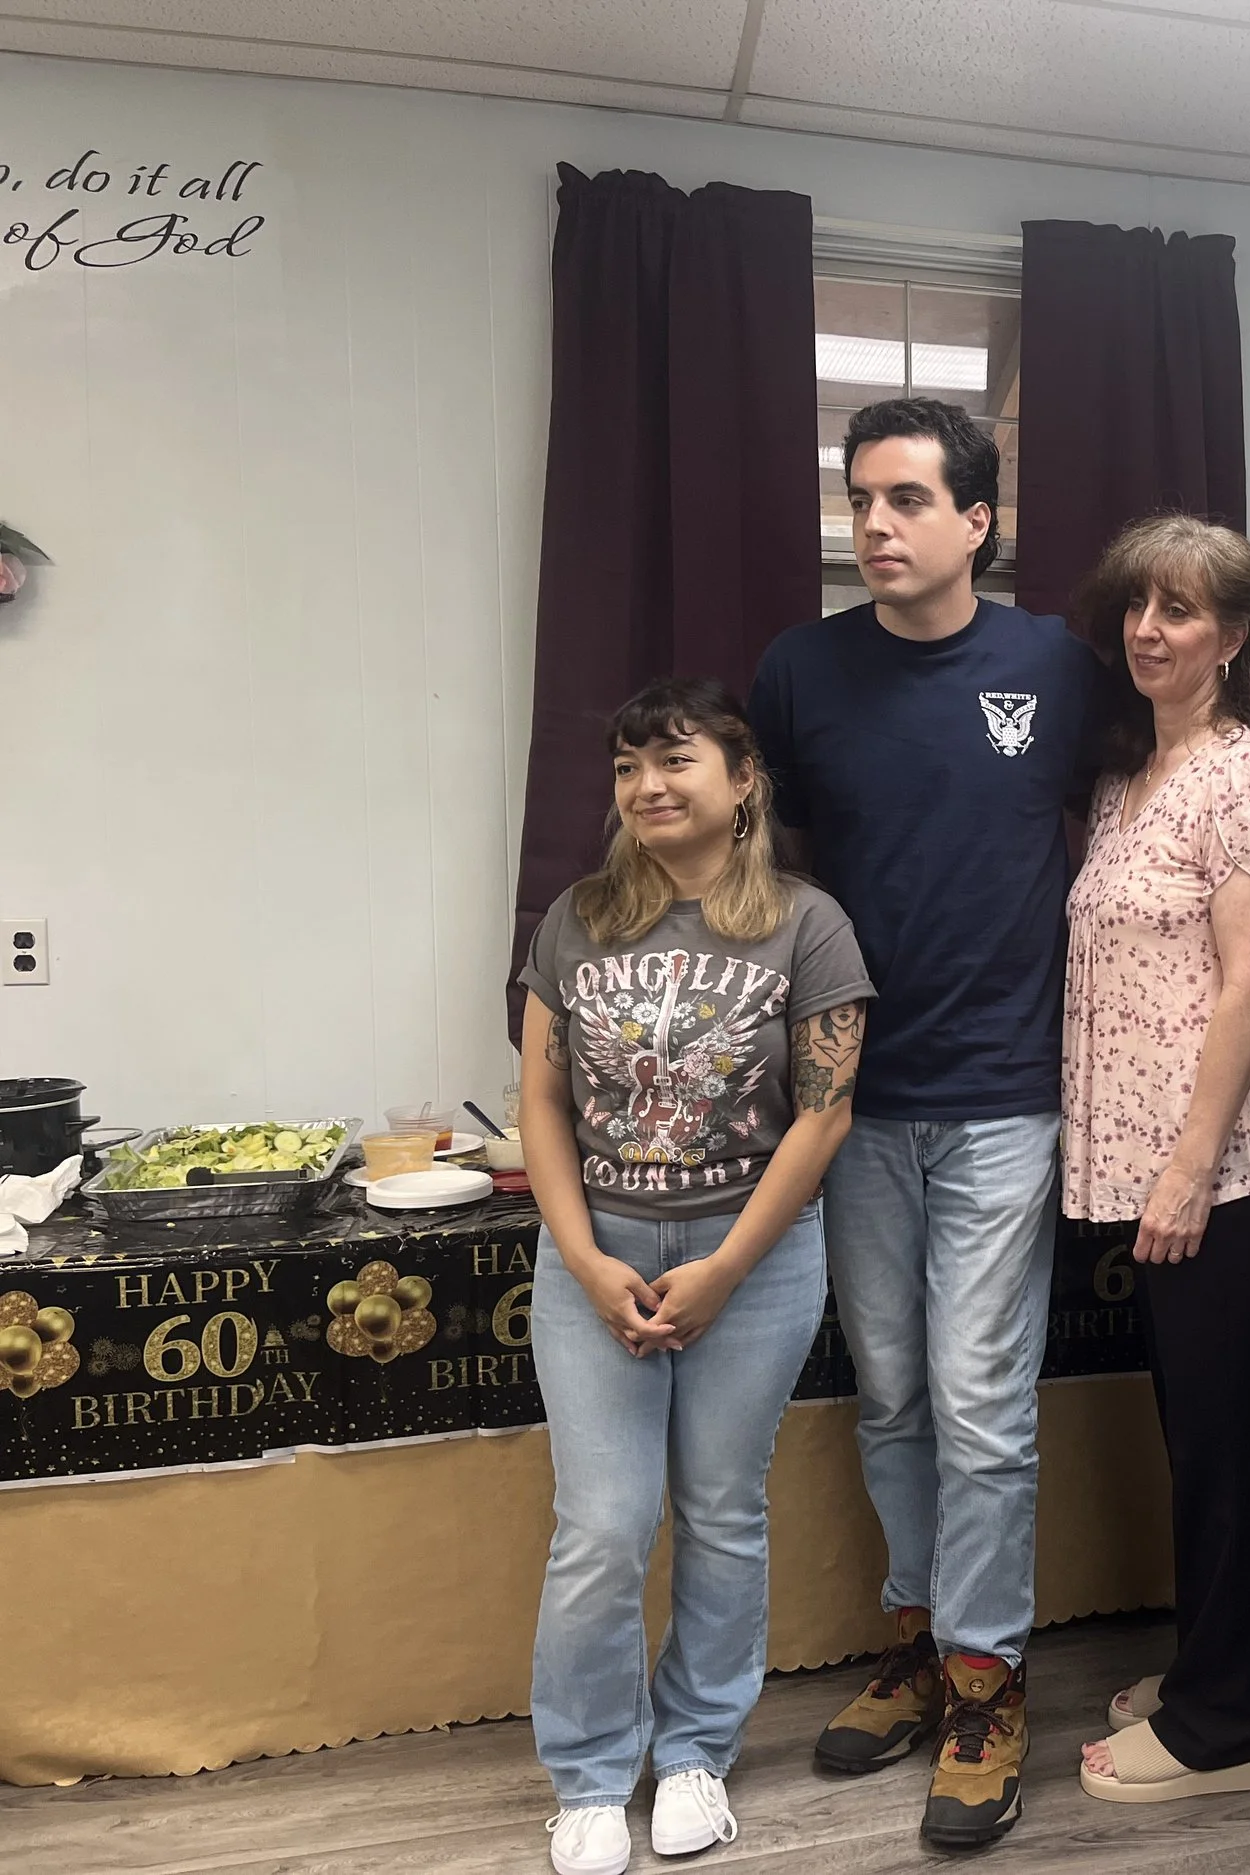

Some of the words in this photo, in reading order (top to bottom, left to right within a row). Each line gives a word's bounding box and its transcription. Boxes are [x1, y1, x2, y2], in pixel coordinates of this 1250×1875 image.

[45, 149, 111, 193] do
[127, 163, 170, 197] it
[178, 160, 264, 202] all
[3, 208, 79, 271] of
[73, 213, 265, 268] God
[1003, 700, 1015, 711] &
[687, 952, 790, 1017] LIVE
[114, 1258, 282, 1309] HAPPY
[143, 1311, 259, 1382] 60
[427, 1353, 538, 1391] BIRT
[70, 1371, 322, 1430] BIRTHDAY
